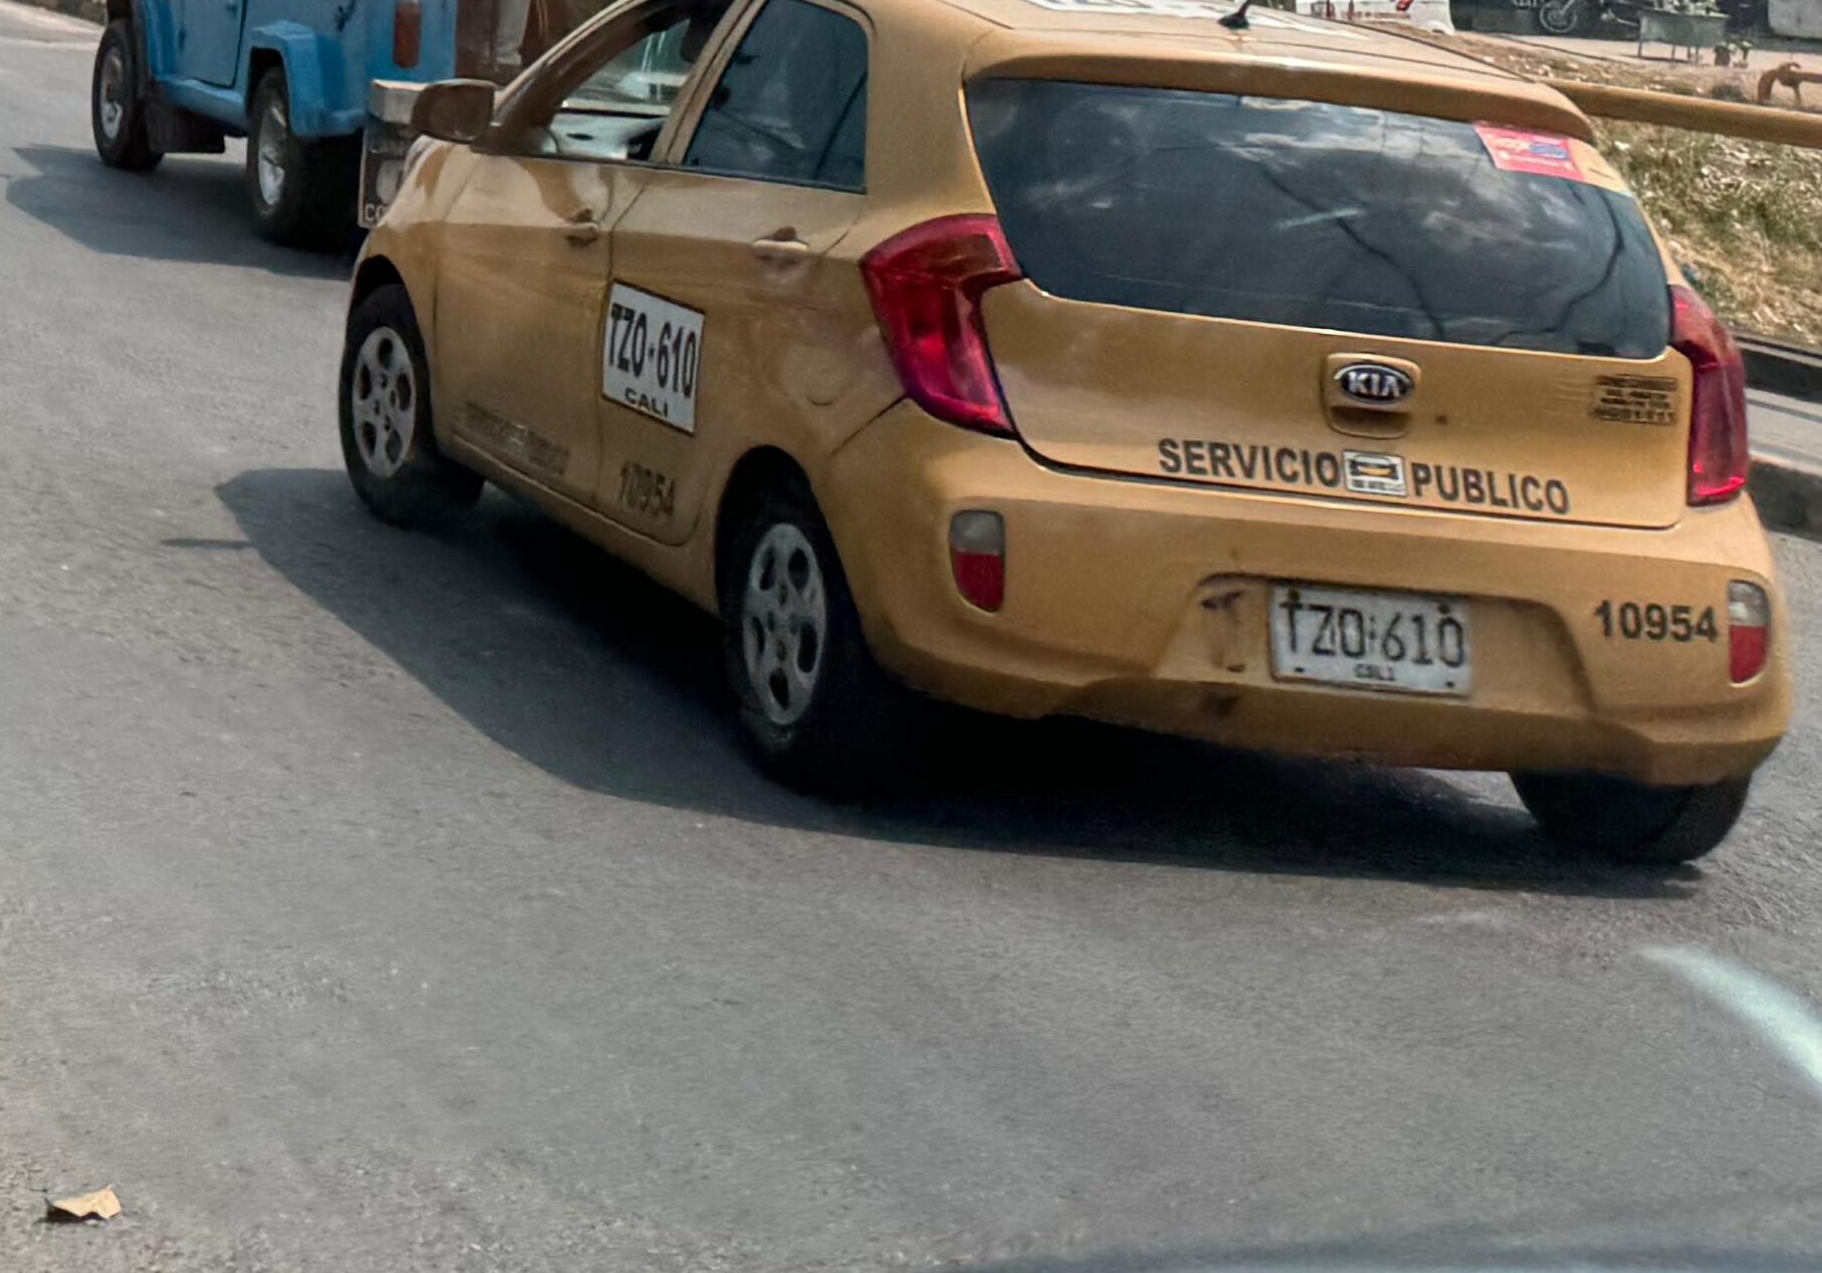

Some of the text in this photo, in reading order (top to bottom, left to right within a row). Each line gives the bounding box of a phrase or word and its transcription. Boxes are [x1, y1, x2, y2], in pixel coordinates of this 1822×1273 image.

[625, 387, 669, 417] CALI
[1347, 371, 1400, 398] KIA
[619, 461, 676, 518] 10954
[1158, 437, 1570, 515] SERVICIO PUBLICO
[1595, 600, 1718, 643] 10954
